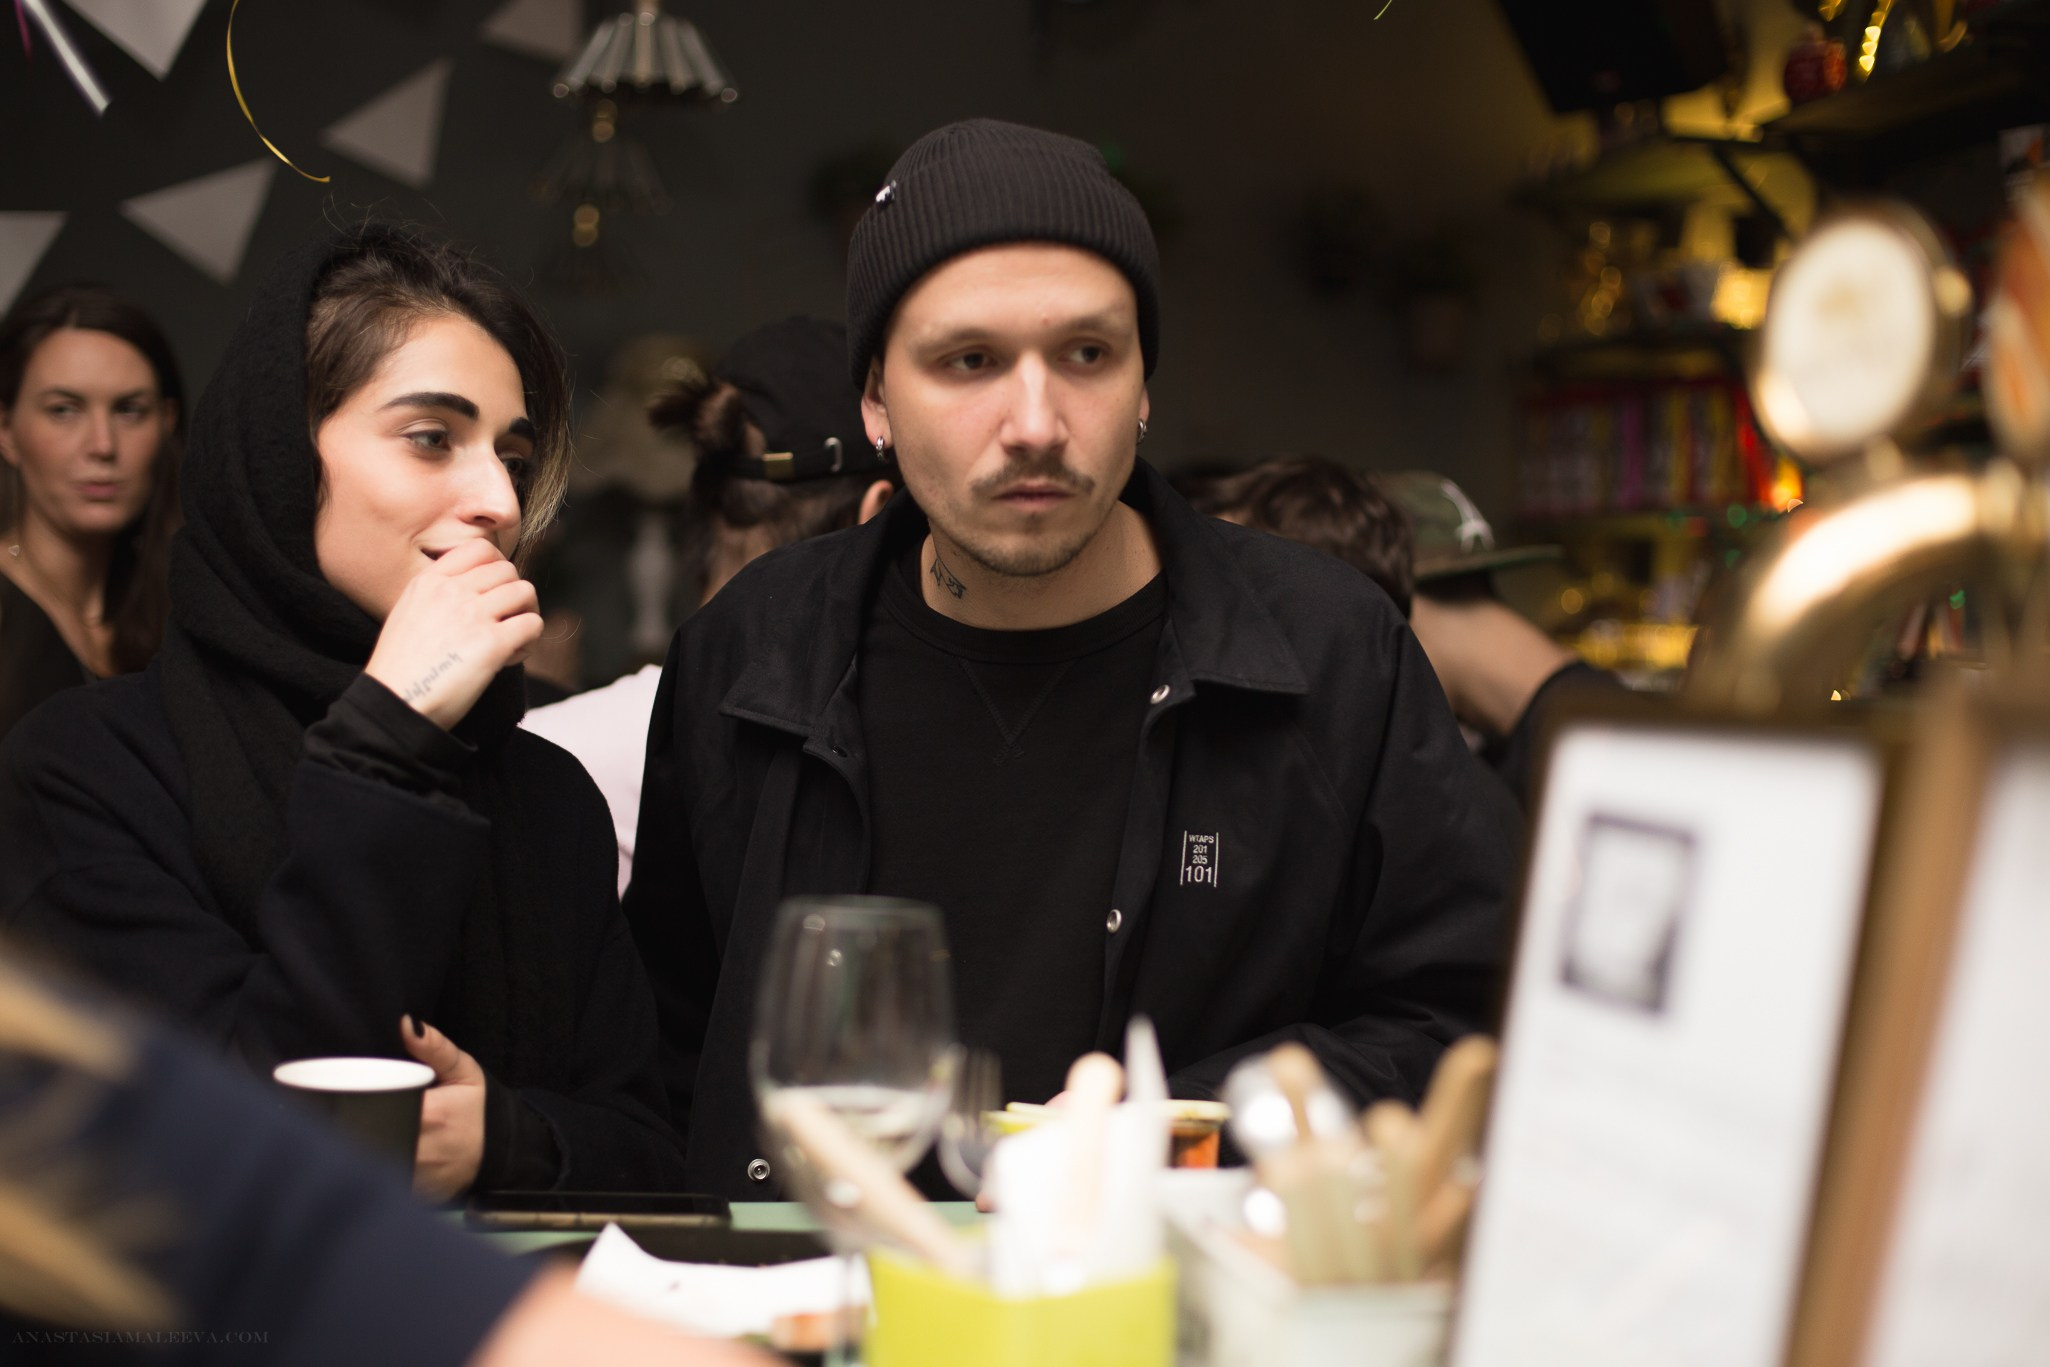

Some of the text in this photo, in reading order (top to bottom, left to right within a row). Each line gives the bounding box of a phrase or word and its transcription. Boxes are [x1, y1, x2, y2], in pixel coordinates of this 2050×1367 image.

[1189, 834, 1215, 844] WTAPS
[1192, 844, 1208, 854] 201
[1192, 854, 1208, 865] 205
[1185, 865, 1212, 883] 101
